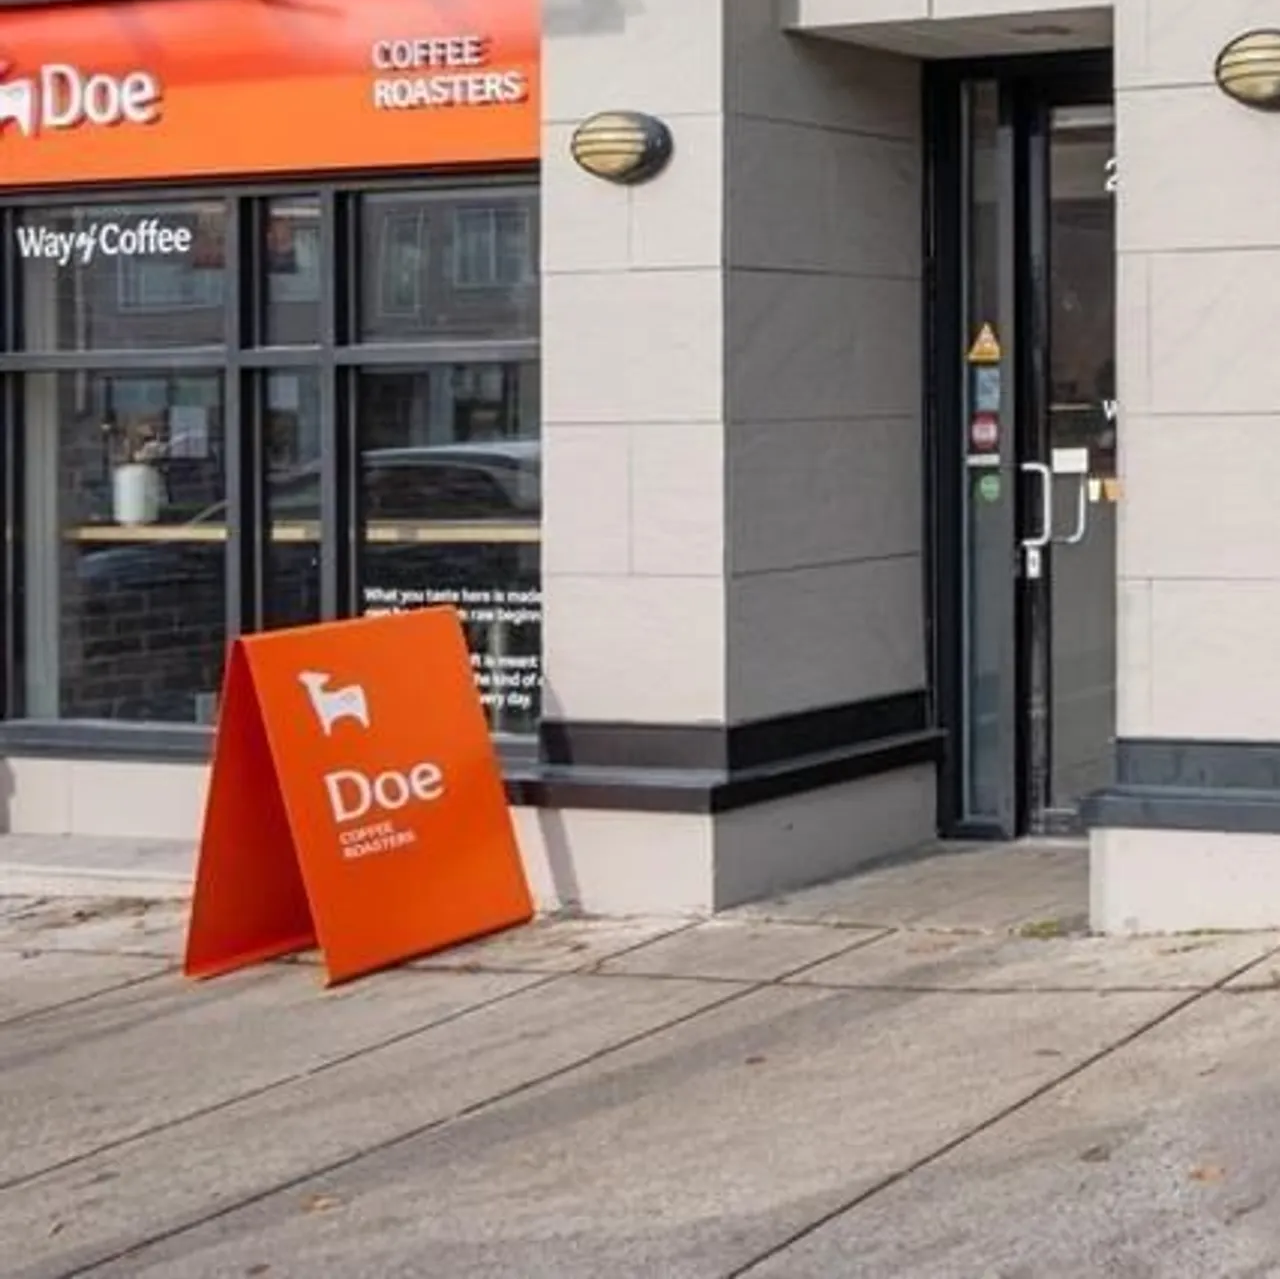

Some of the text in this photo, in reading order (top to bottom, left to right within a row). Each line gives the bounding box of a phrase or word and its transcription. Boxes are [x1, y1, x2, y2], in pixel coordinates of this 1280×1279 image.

[372, 36, 484, 69] COFFEE
[41, 63, 158, 127] Doe
[374, 71, 525, 109] ROASTERS
[17, 226, 74, 266] Way
[100, 217, 192, 255] Coffee
[364, 587, 397, 603] What
[401, 591, 423, 604] you
[462, 587, 491, 602] here
[324, 762, 444, 823] Doe
